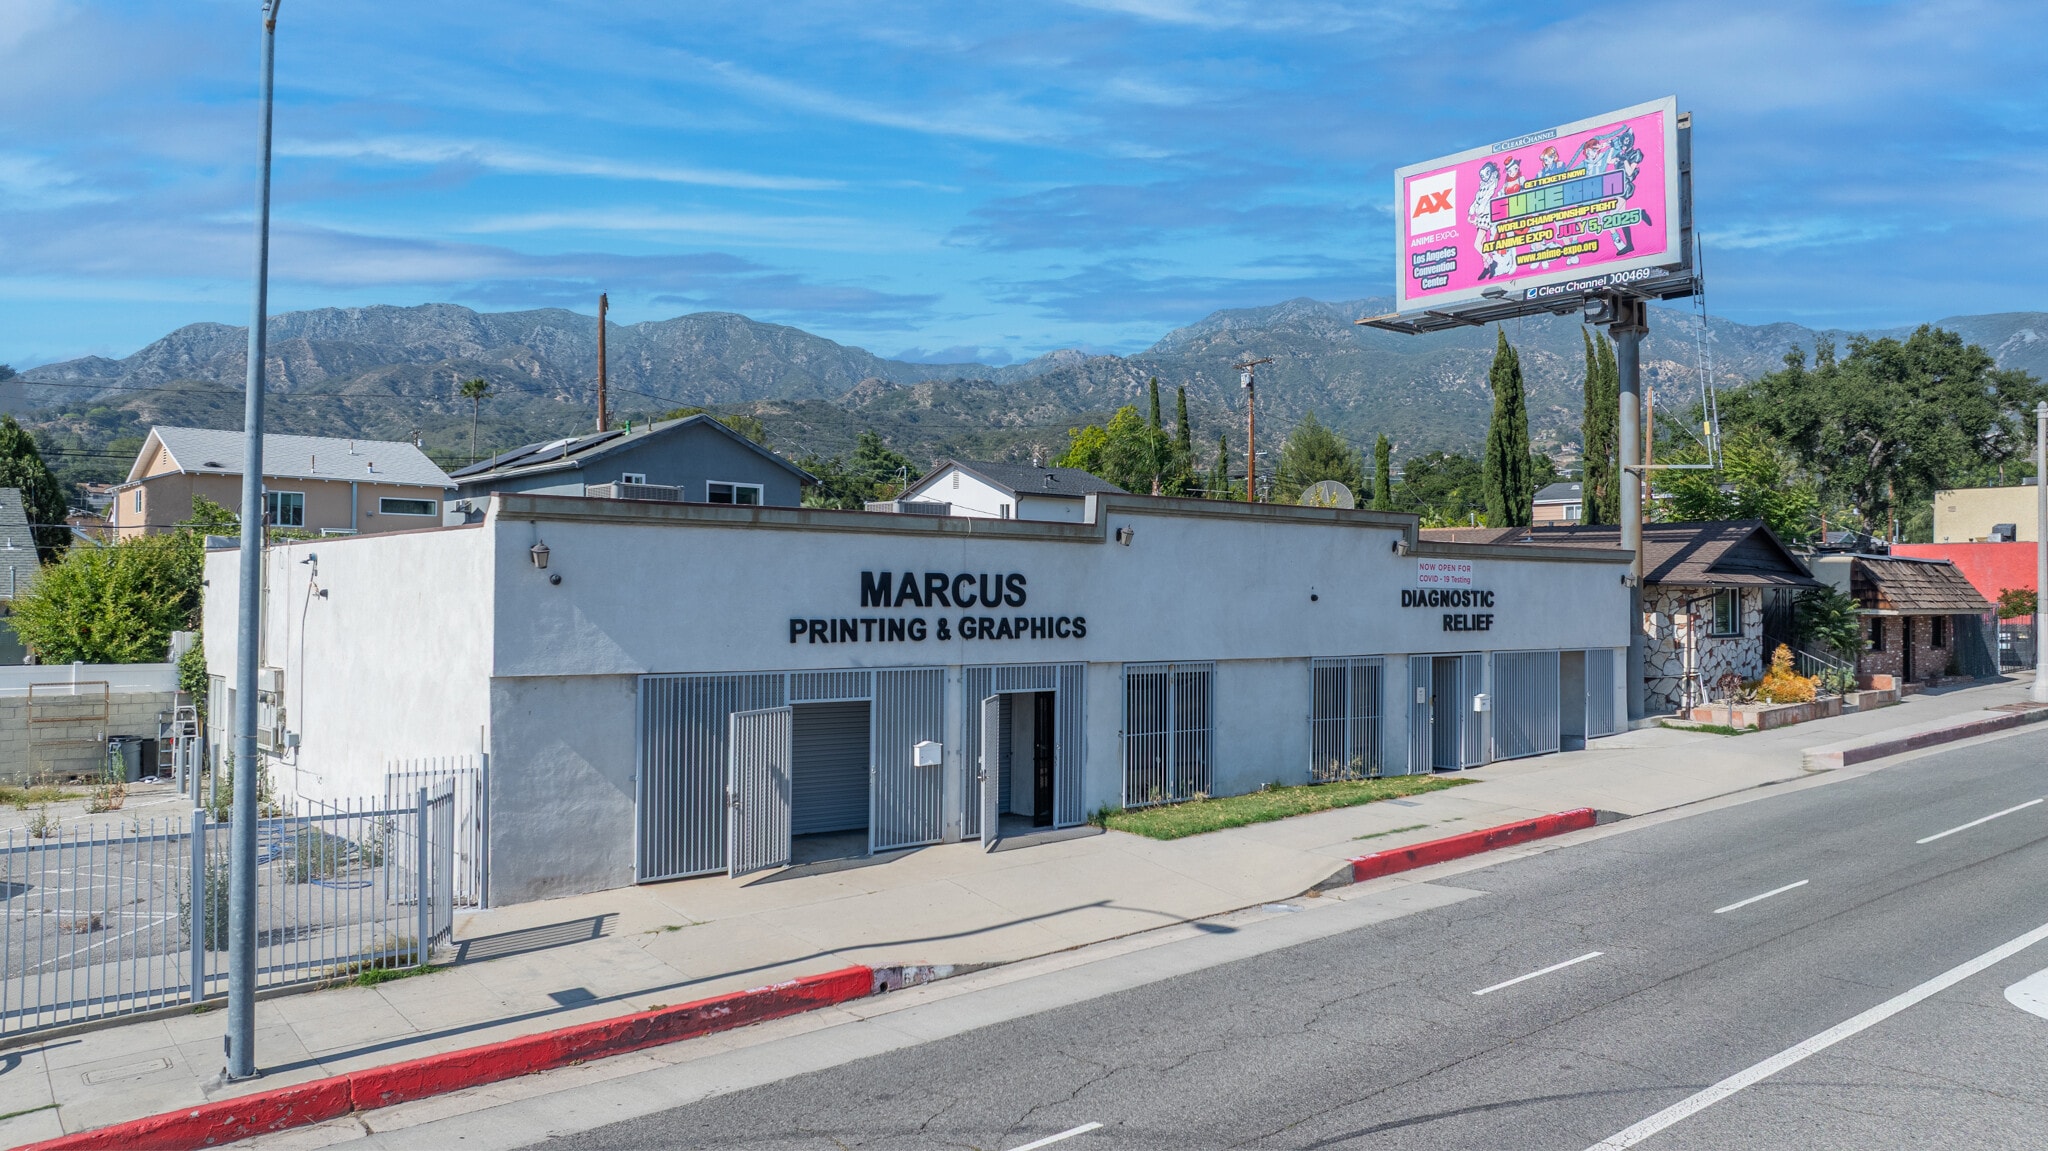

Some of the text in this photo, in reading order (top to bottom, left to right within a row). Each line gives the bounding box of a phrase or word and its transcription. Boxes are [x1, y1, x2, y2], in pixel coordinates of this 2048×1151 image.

[1524, 168, 1586, 189] GET TICKETS NOW!
[1412, 188, 1453, 218] AX
[1497, 200, 1617, 233] WORLD CHAMPIONSHIP FIGHT
[1411, 234, 1435, 247] ANIME
[1483, 209, 1641, 252] AT ANIME EXPO JULY 5, 2025
[1413, 247, 1456, 265] Los Angeles
[1516, 240, 1598, 265] www.anime-expo.org
[1413, 261, 1456, 277] Convention
[1422, 275, 1448, 289] Center
[1539, 285, 1565, 297] Clear
[1566, 276, 1607, 294] Channel
[1419, 563, 1471, 573] NOW OPEN FOR
[860, 571, 1027, 608] MARCUS
[1419, 574, 1439, 583] COVID
[1443, 575, 1450, 583] 19
[1451, 576, 1471, 585] Testing
[1401, 589, 1495, 608] DIAGNOSTIC
[789, 616, 1087, 644] PRINTING & GRAPHICS
[1443, 613, 1494, 632] RELIEF
